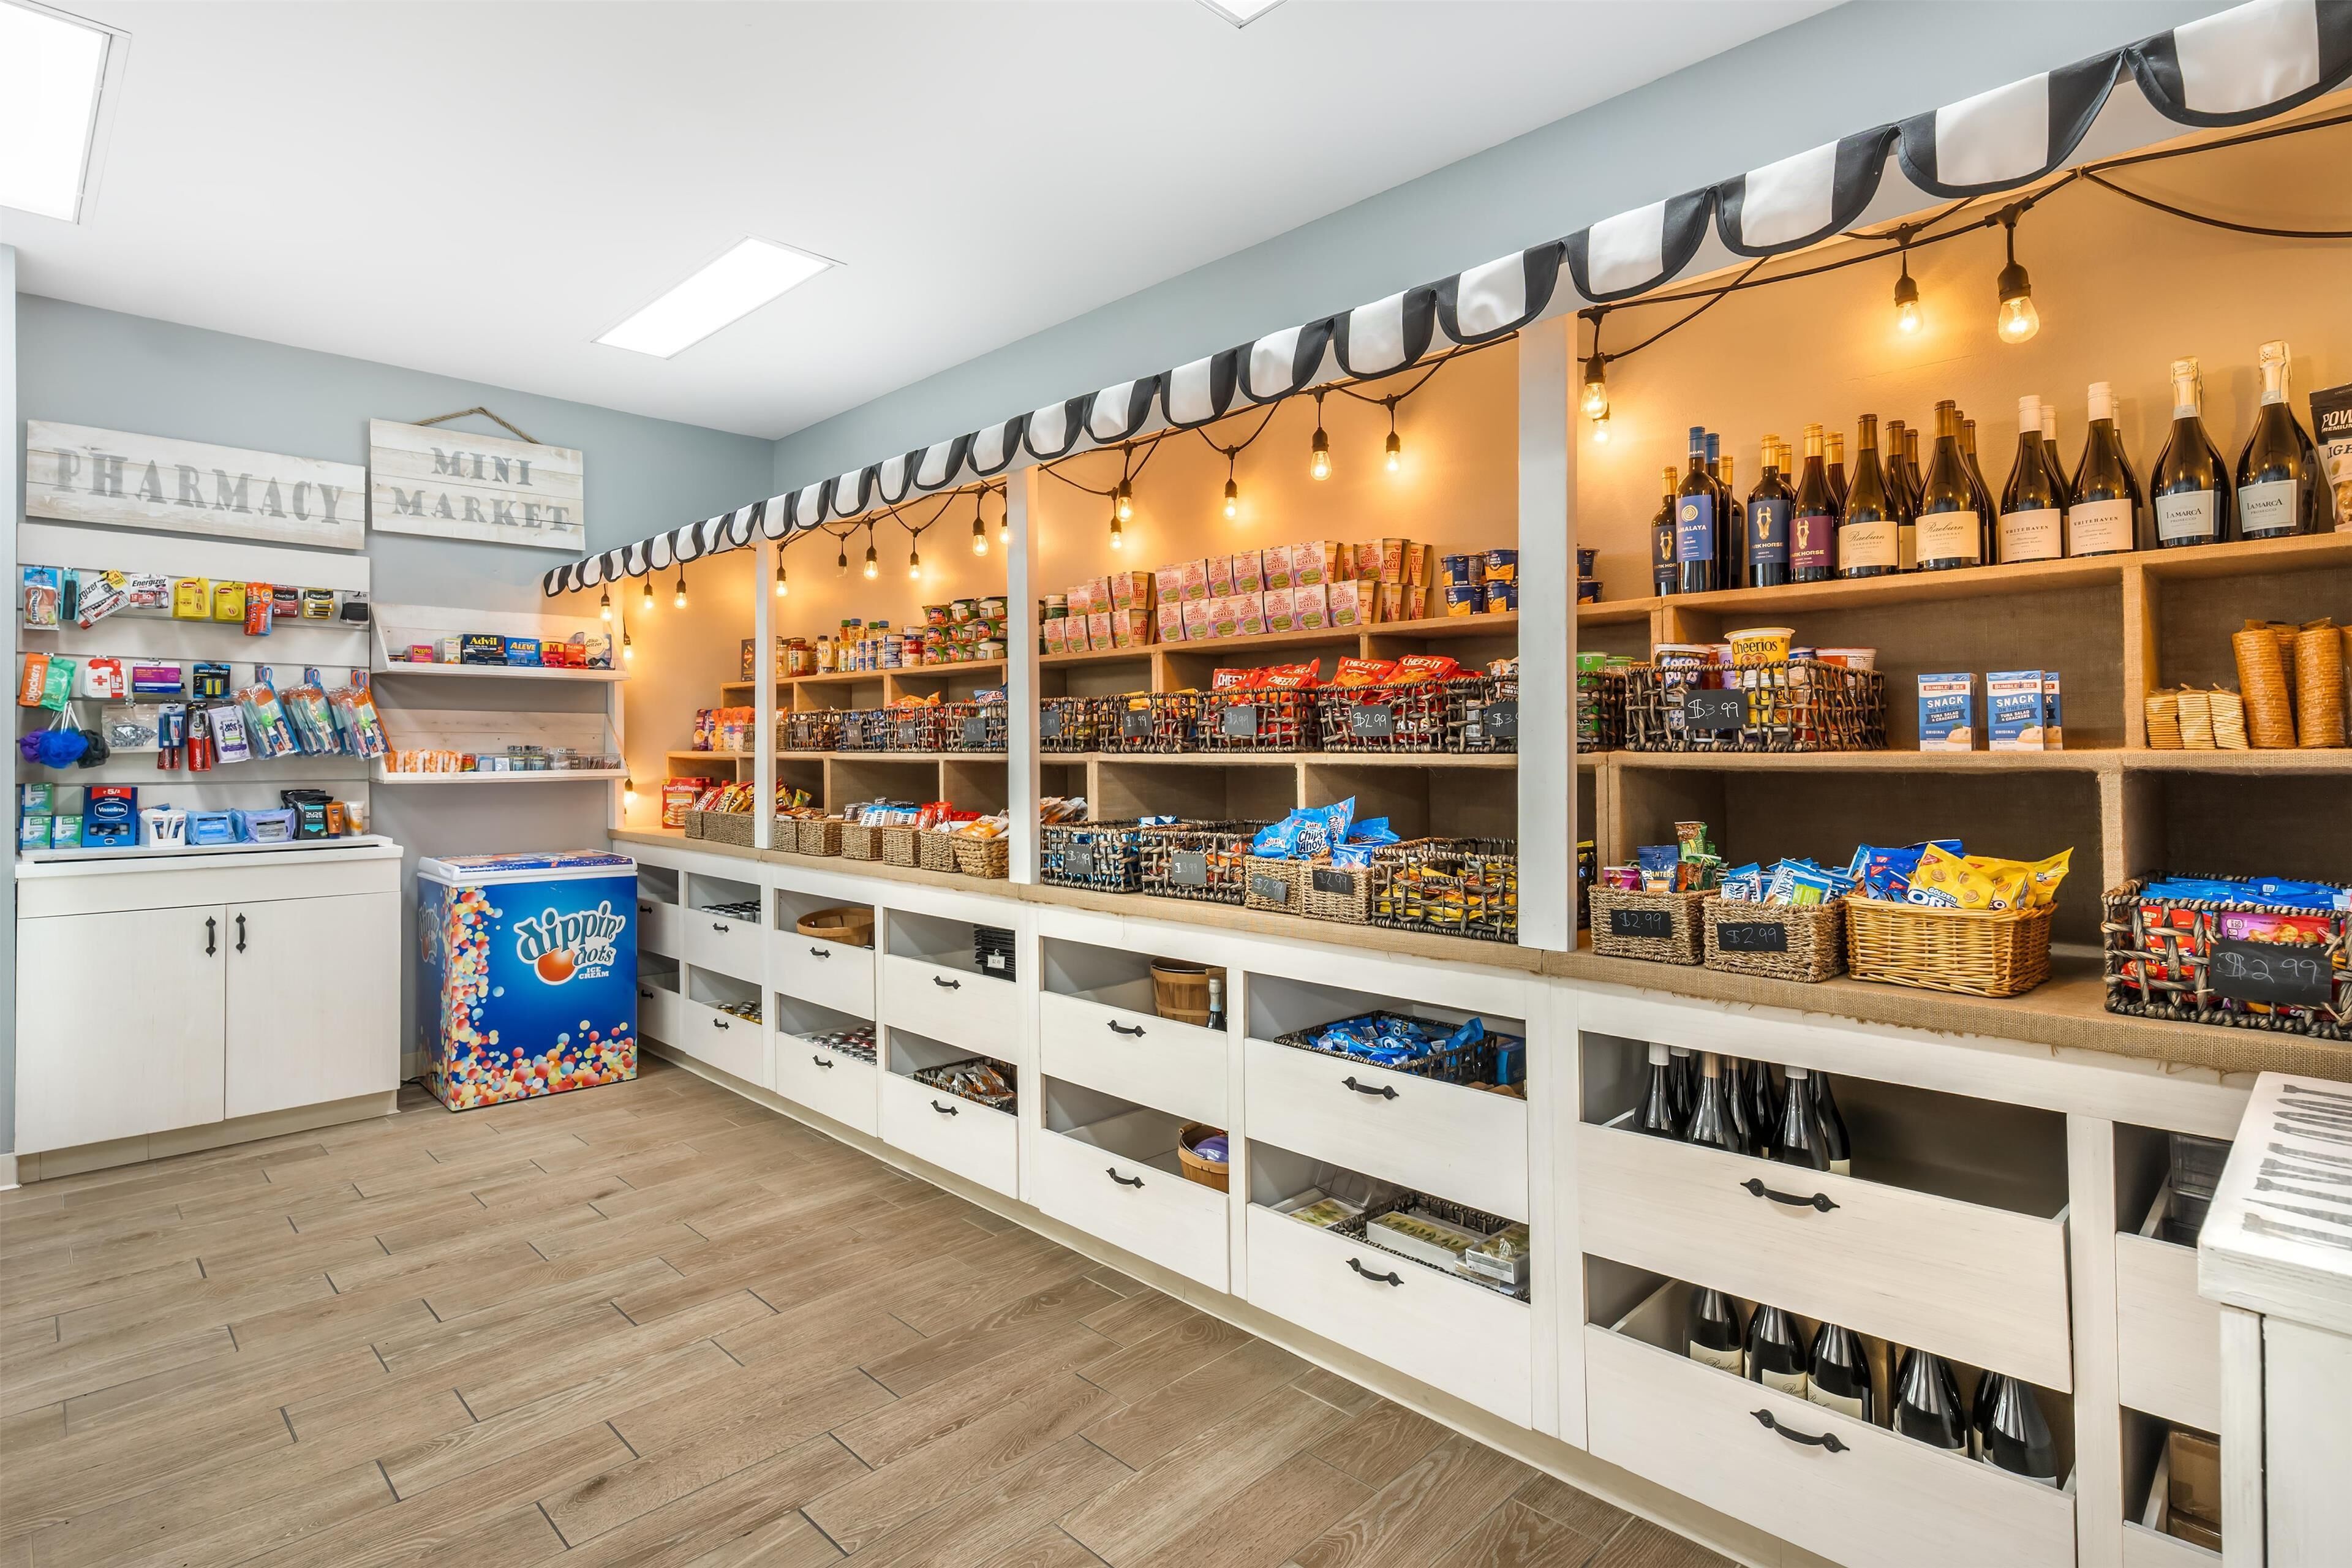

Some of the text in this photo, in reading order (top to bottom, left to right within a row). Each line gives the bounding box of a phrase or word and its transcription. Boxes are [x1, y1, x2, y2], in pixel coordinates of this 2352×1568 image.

[430, 447, 533, 486] MINI
[53, 447, 344, 526] PHARMACY
[390, 487, 571, 532] MARKET
[1924, 521, 1964, 534] Raeburn
[2073, 516, 2119, 527] WHITEHAVEN
[2005, 525, 2049, 535] WHITEHAVEN
[1846, 530, 1885, 543] Raeburn
[1297, 556, 1321, 566] NOODLES
[1361, 554, 1380, 564] NOODLES
[1237, 564, 1258, 574] NOODLES
[1267, 561, 1289, 570] NOODLES
[1185, 574, 1203, 582] NOODLES
[1210, 569, 1229, 578] NOODLES
[132, 578, 167, 587] Energizer
[31, 589, 40, 622] mentos
[1298, 600, 1321, 609] NOODLES
[1332, 596, 1354, 605] NOODLES
[1213, 609, 1235, 618] NOODLES
[1240, 606, 1260, 615] NOODLES
[1268, 603, 1291, 612] NOODLES
[470, 636, 497, 646] Advil
[510, 642, 536, 650] ALEVE
[1733, 638, 1777, 655] Cheerios
[27, 665, 41, 702] plackers
[1927, 696, 1964, 708] SNACK
[1996, 695, 2034, 707] SNACK
[1687, 699, 1740, 720] $3.99
[1353, 712, 1387, 728] $2.99
[1305, 821, 1322, 831] Mini
[1298, 829, 1324, 843] Chips
[1253, 878, 1283, 896] $2.99
[1907, 890, 1959, 908] ORE
[1928, 887, 1958, 903] GOLDEN
[1619, 912, 1662, 930] $2.99
[1725, 927, 1777, 944] $2.99
[573, 945, 614, 967] dots
[578, 970, 609, 980] CREAM
[1706, 1357, 1740, 1371] Raeburn
